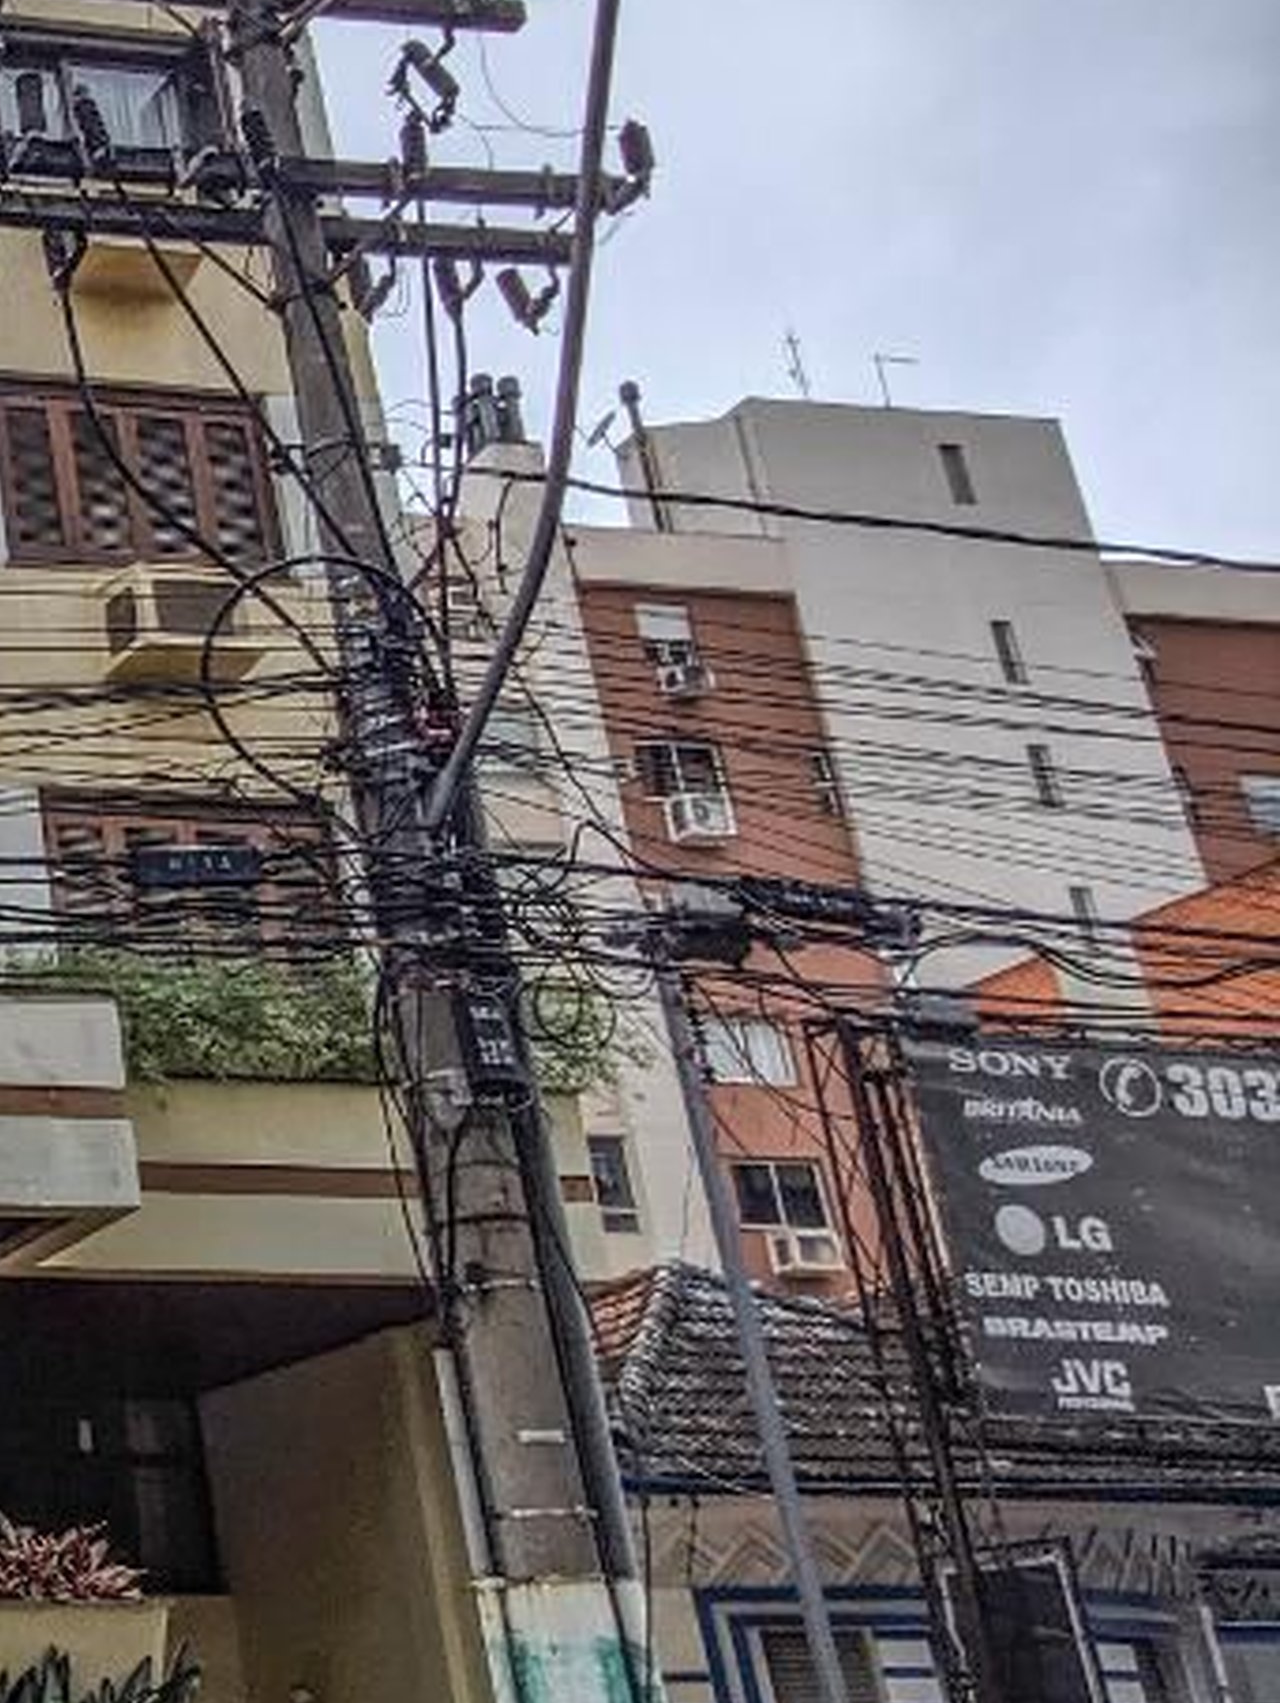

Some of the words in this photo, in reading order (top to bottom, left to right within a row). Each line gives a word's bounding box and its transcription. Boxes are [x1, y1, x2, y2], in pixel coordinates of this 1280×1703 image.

[949, 1048, 1070, 1079] SONY
[1051, 1215, 1112, 1251] LG
[965, 1272, 1039, 1300] SEMP
[1046, 1275, 1170, 1308] TOSHIBA
[983, 1316, 1168, 1346] BRASTEMP
[1051, 1358, 1131, 1397] JVC
